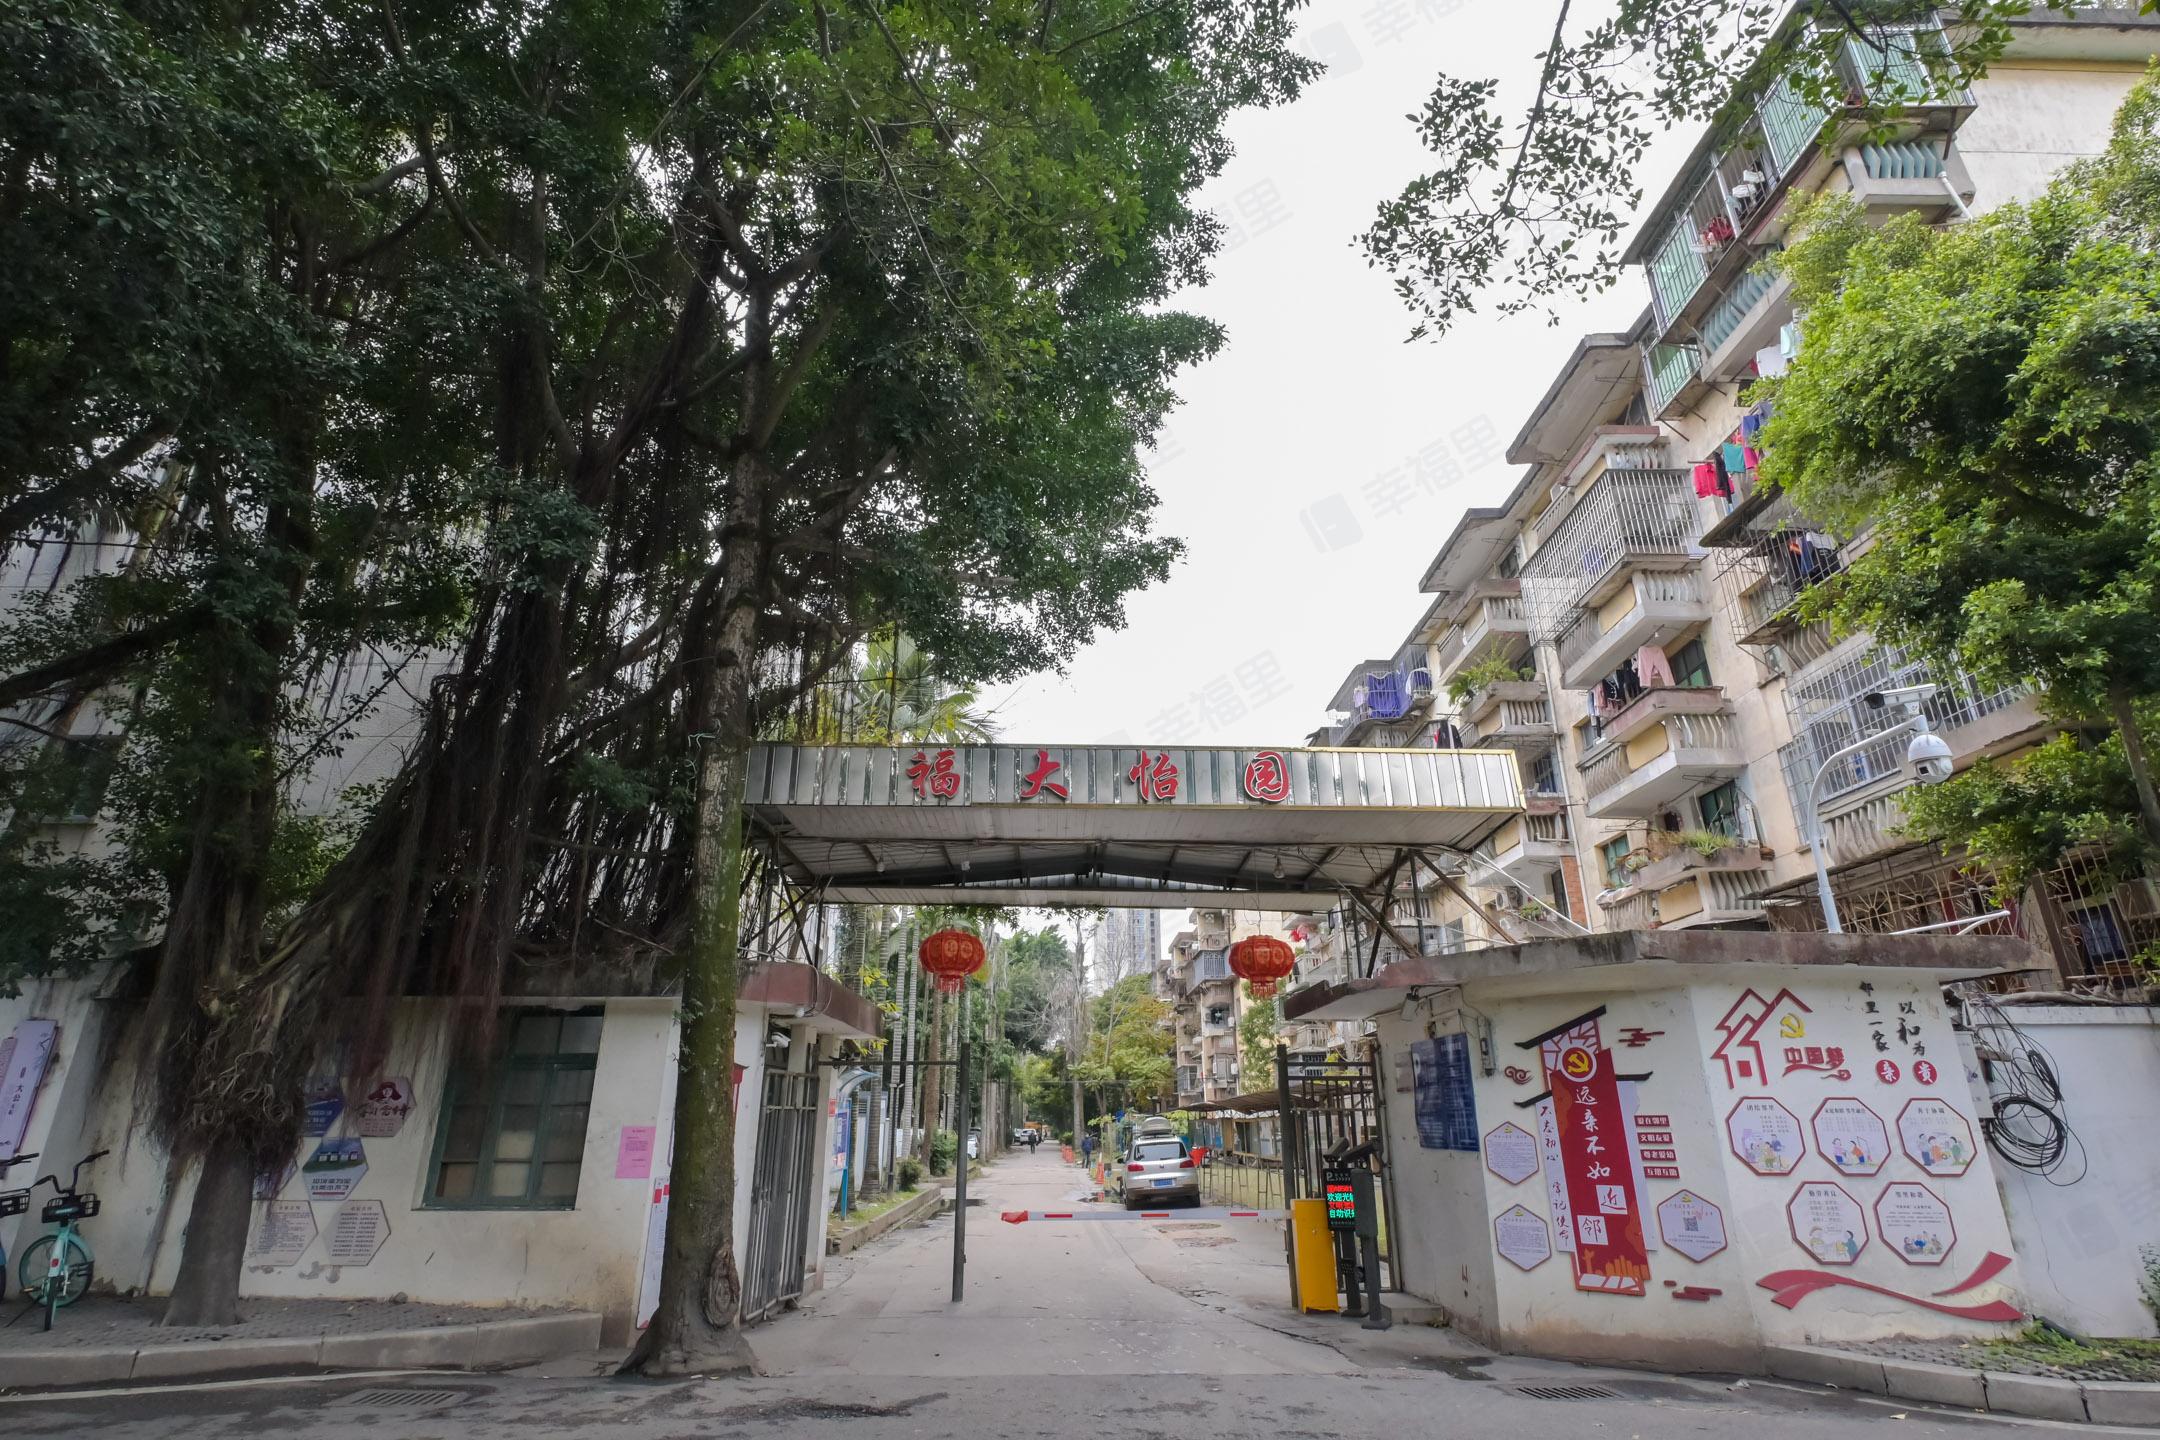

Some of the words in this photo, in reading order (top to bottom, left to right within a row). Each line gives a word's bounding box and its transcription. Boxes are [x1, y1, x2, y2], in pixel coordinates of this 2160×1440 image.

[906, 749, 1291, 802] 福大怡园
[1784, 1046, 1845, 1069] 中国梦
